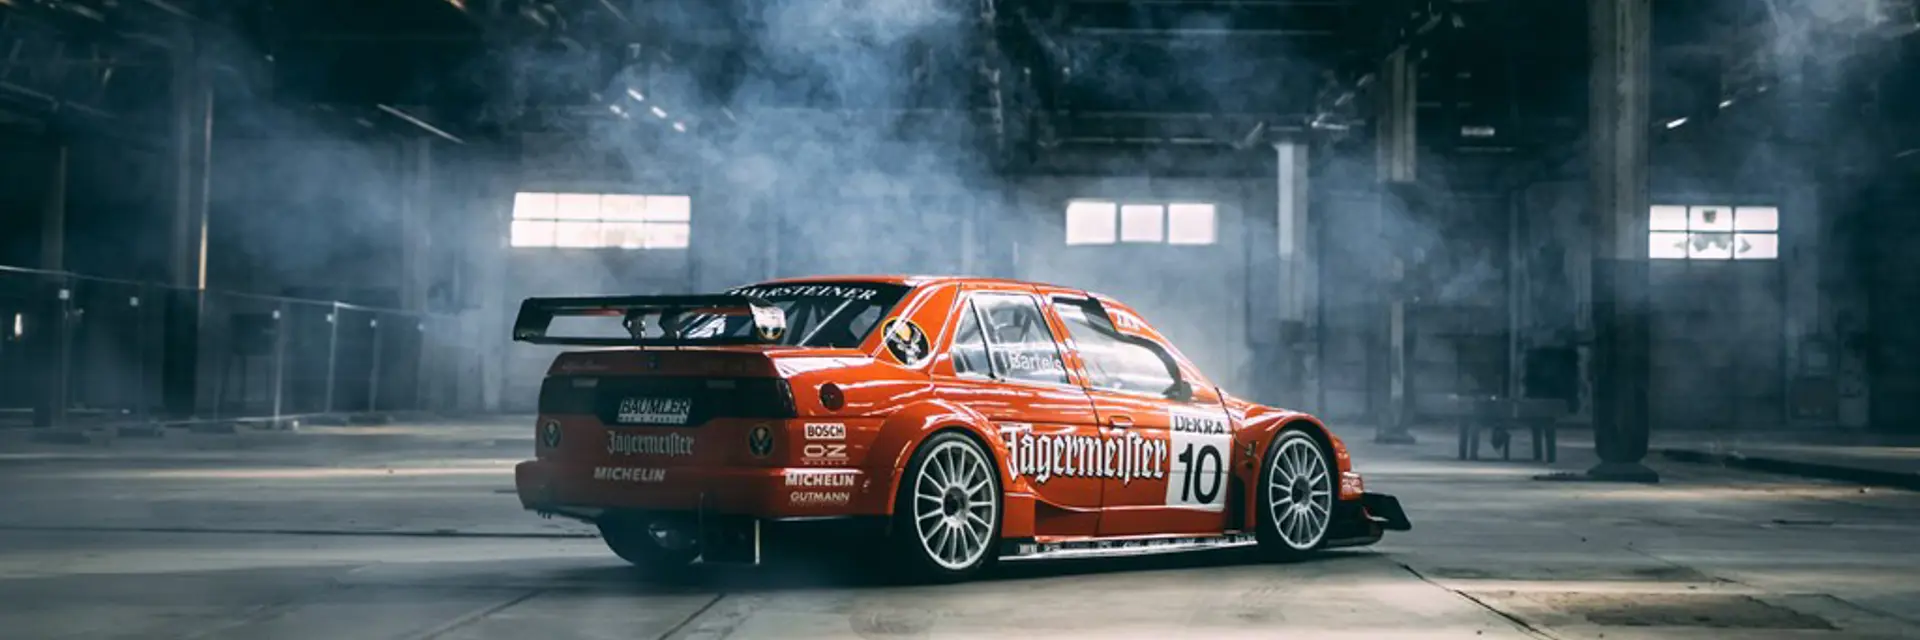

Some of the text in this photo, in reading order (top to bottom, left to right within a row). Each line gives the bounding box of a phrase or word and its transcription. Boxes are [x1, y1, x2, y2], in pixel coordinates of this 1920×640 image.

[1010, 351, 1062, 371] Bartels
[807, 425, 844, 437] BOSCH
[1174, 415, 1224, 434] DEKRA
[804, 444, 848, 458] OZ
[594, 466, 667, 482] MICHELIN
[785, 473, 855, 487] MICHELIN
[1179, 443, 1223, 504] 10
[790, 491, 850, 503] GUTMANN
